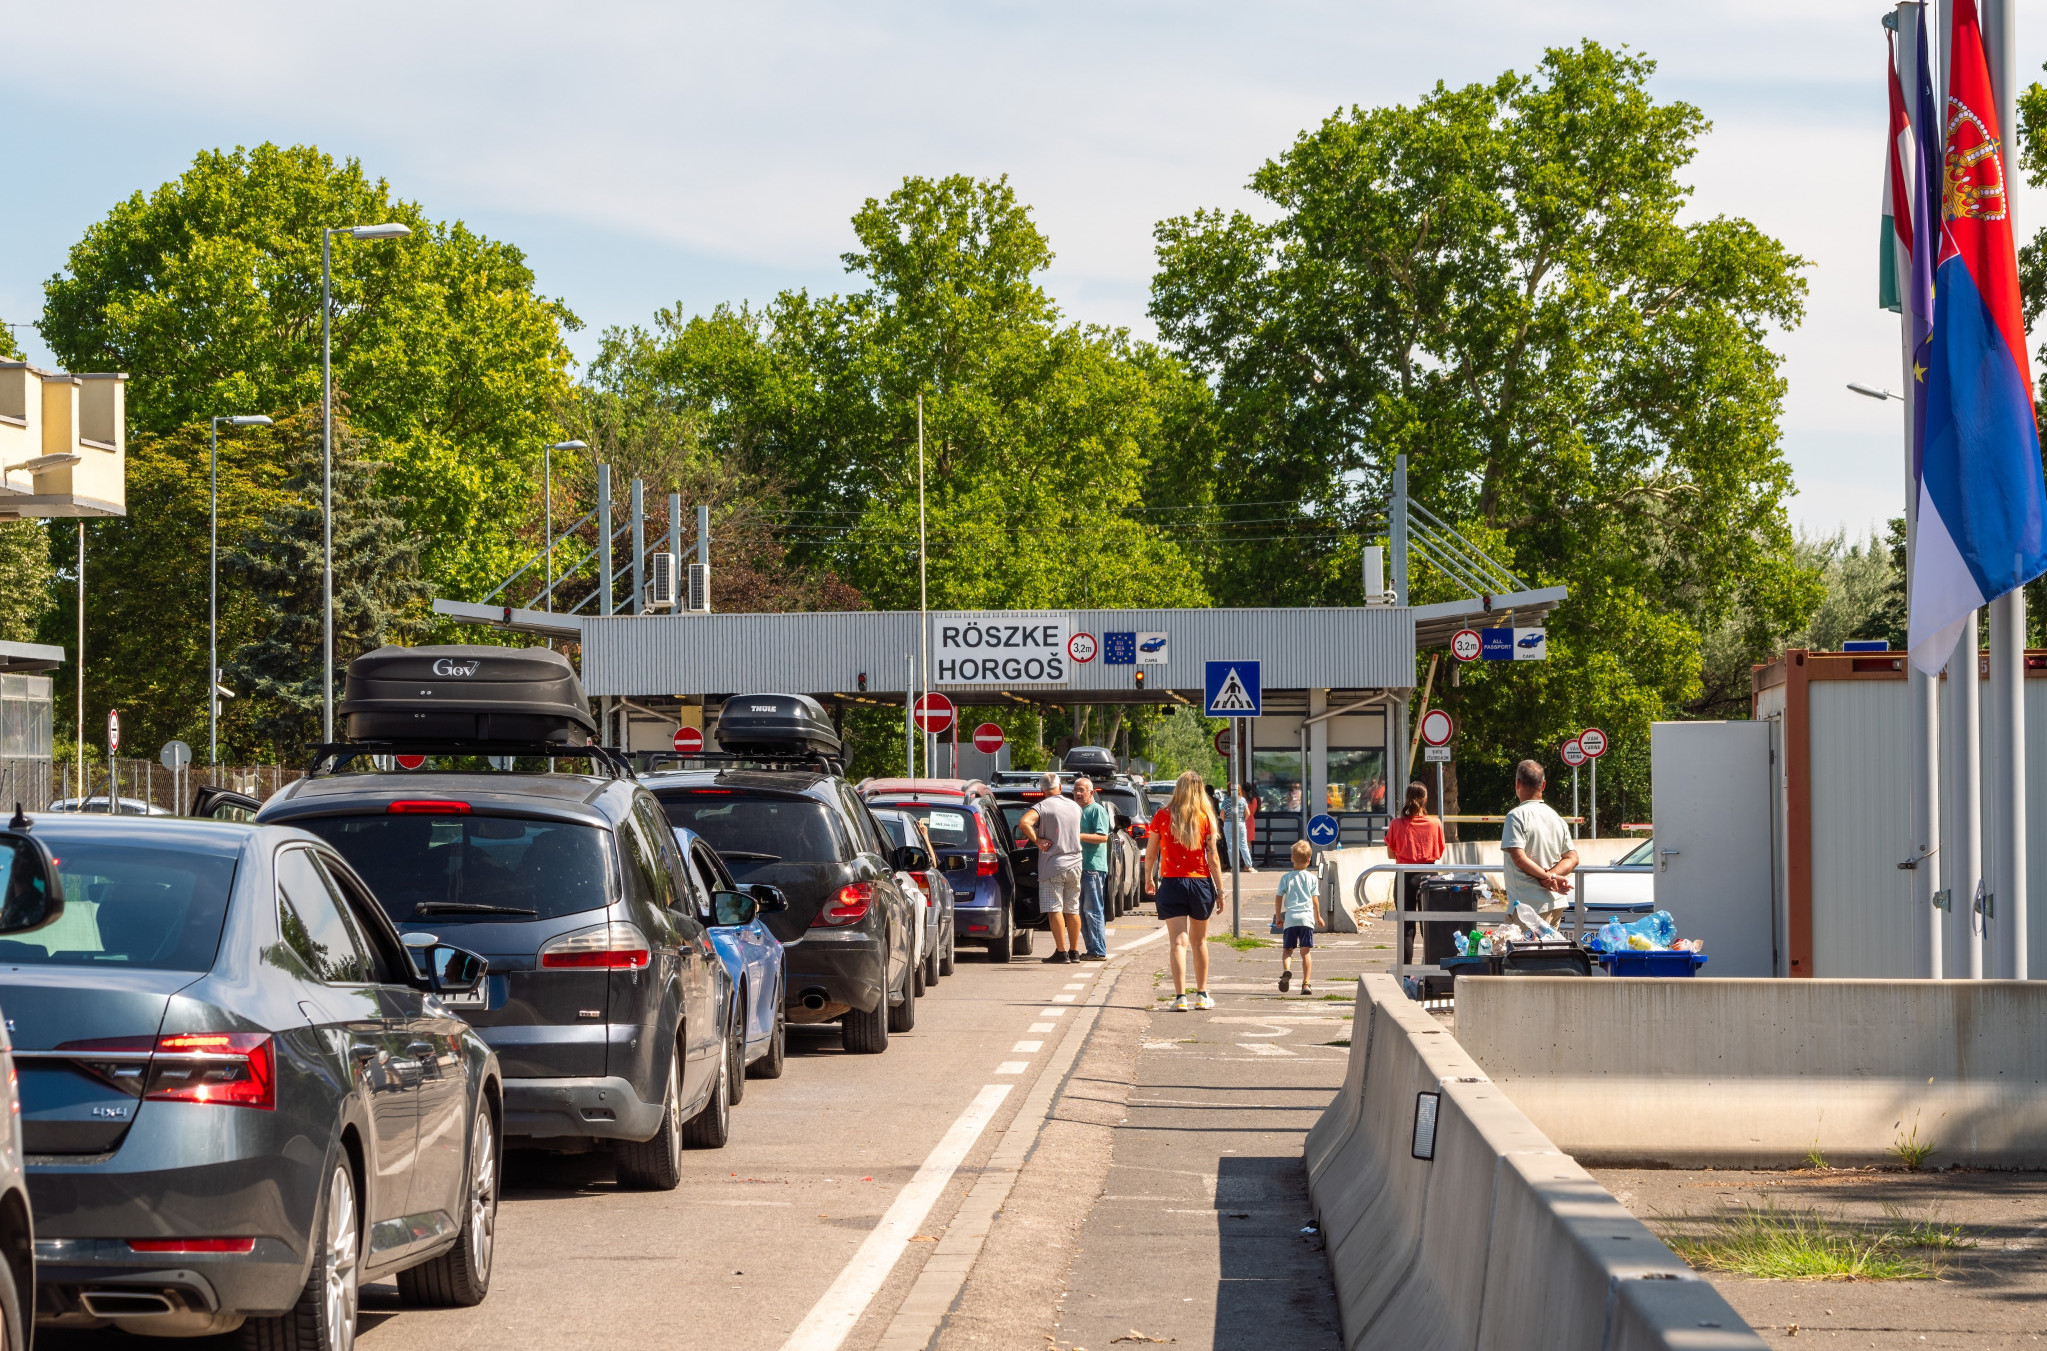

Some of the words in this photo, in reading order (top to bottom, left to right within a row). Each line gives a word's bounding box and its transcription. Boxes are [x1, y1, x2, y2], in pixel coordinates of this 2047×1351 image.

[942, 622, 1059, 648] RÖSZKE
[938, 652, 1064, 680] HORGOŠ
[750, 705, 777, 713] THULE
[92, 1106, 128, 1117] 4x4
